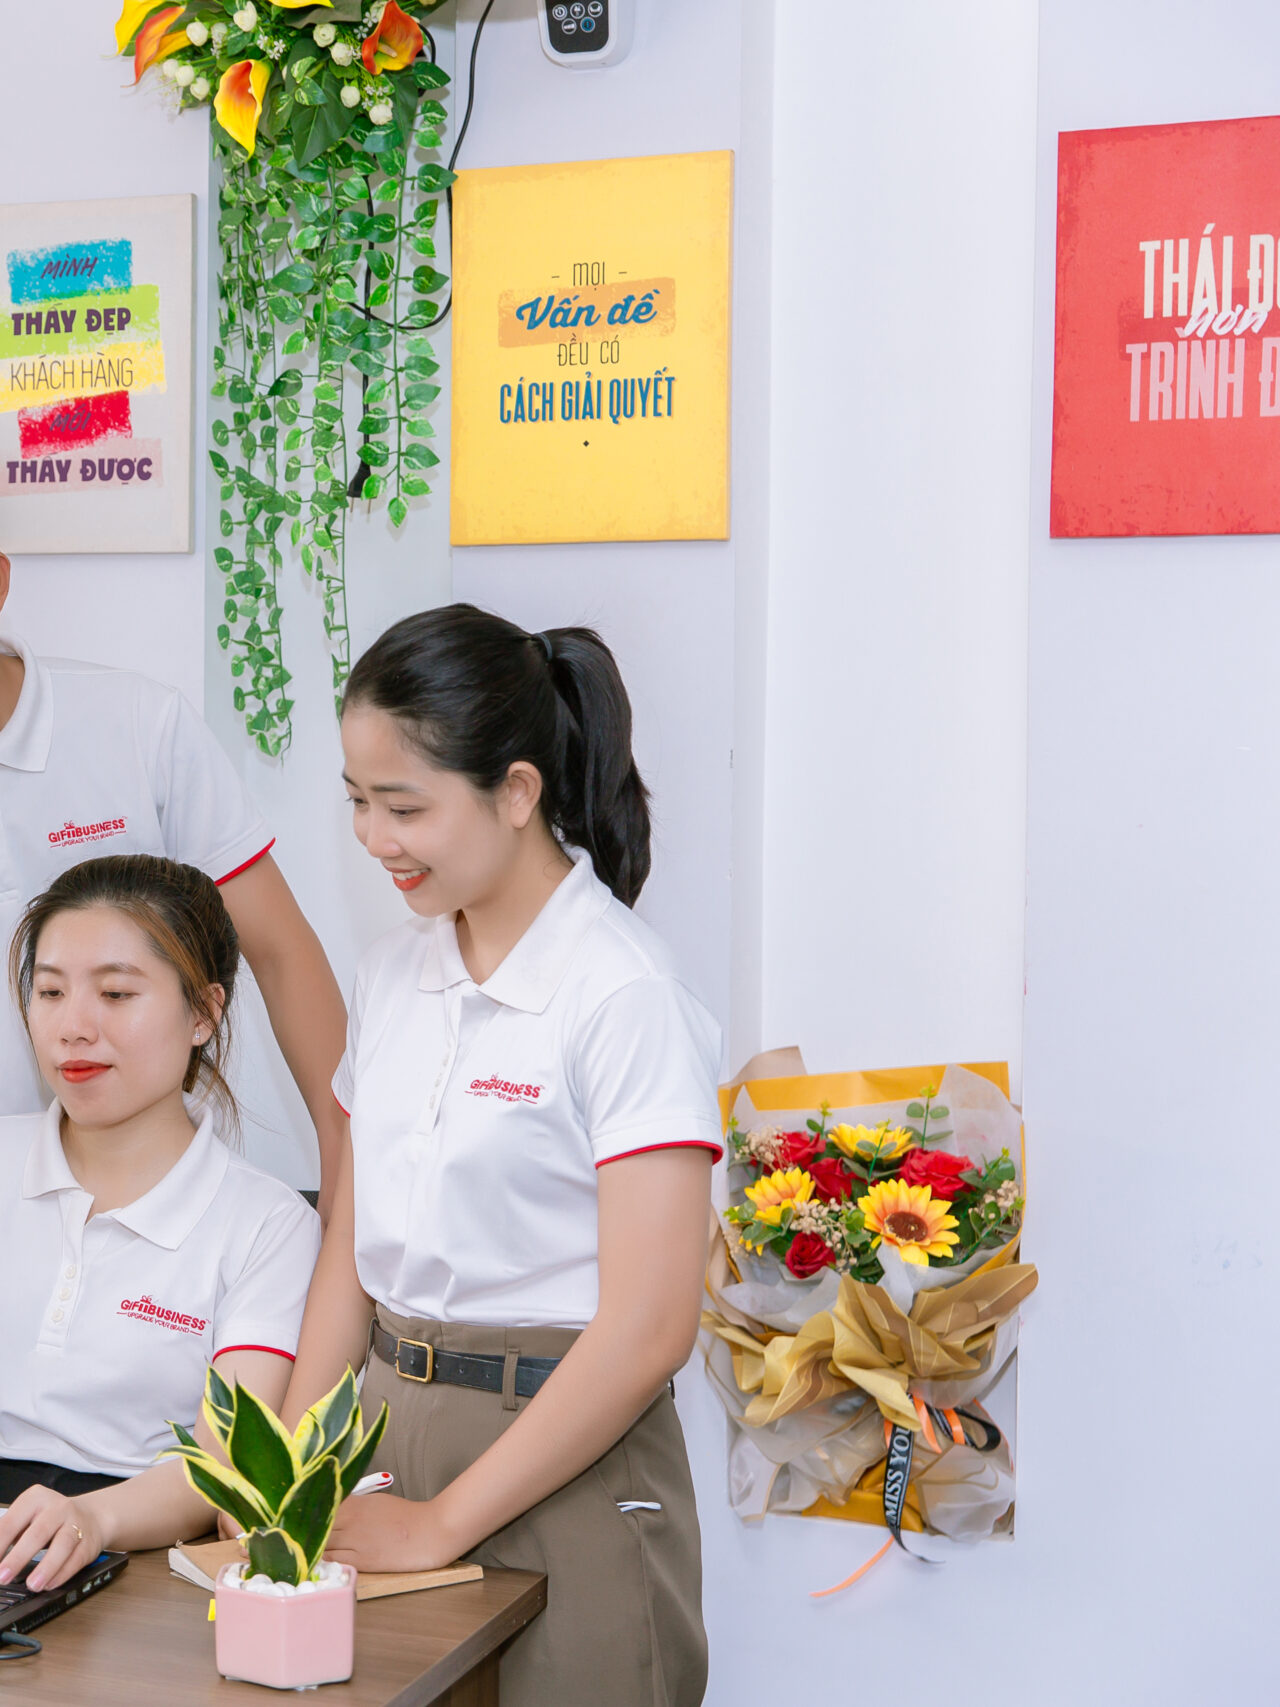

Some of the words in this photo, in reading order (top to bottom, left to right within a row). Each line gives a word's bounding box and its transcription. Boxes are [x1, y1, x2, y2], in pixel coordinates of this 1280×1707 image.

[40, 253, 98, 280] MÌNH
[1139, 223, 1234, 319] THÁI
[1247, 233, 1280, 314] Đ
[85, 307, 131, 336] ĐẸP
[515, 294, 601, 331] Vấn
[607, 289, 661, 326] đề
[557, 332, 589, 367] ĐỀU
[600, 335, 620, 365] CÓ
[10, 354, 75, 392] KHÁCH
[81, 352, 134, 388] HÀNG
[1125, 327, 1245, 422] TRÌNH
[500, 376, 554, 424] CÁCH
[561, 371, 602, 421] GIẢI
[608, 366, 676, 425] QUYẾT
[80, 457, 152, 486] ĐƯỢC
[884, 1469, 904, 1521] MISS
